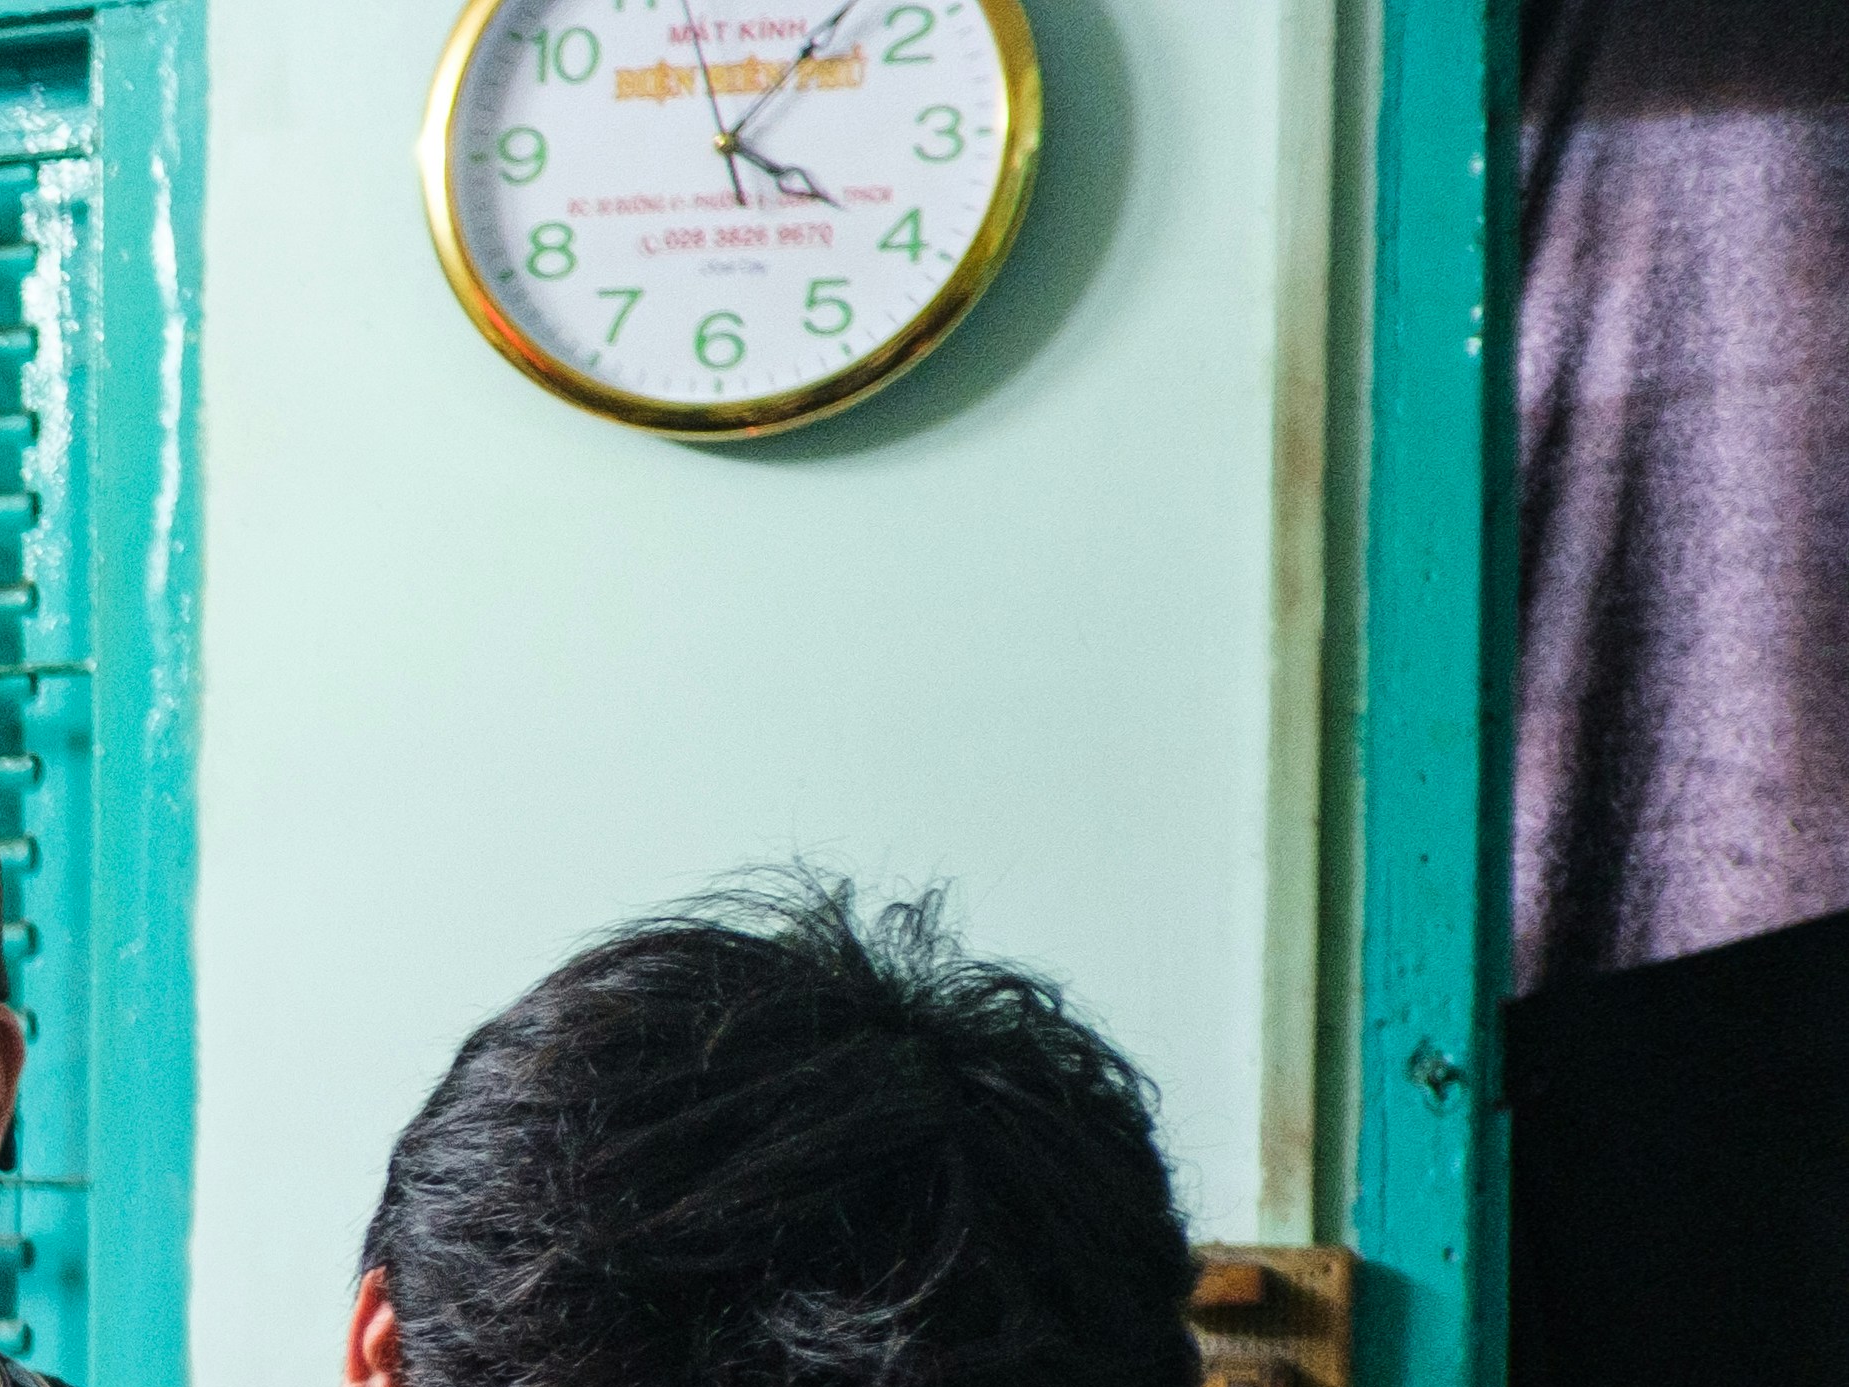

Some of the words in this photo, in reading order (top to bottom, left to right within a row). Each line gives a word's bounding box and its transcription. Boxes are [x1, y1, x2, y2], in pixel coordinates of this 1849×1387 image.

[530, 26, 600, 83] 10
[882, 5, 935, 65] 2
[499, 125, 548, 186] 9
[913, 104, 964, 163] 3
[525, 221, 576, 280] 8
[877, 207, 930, 263] 4
[598, 286, 644, 346] 7
[803, 277, 854, 337] 5
[693, 309, 745, 371] 6
